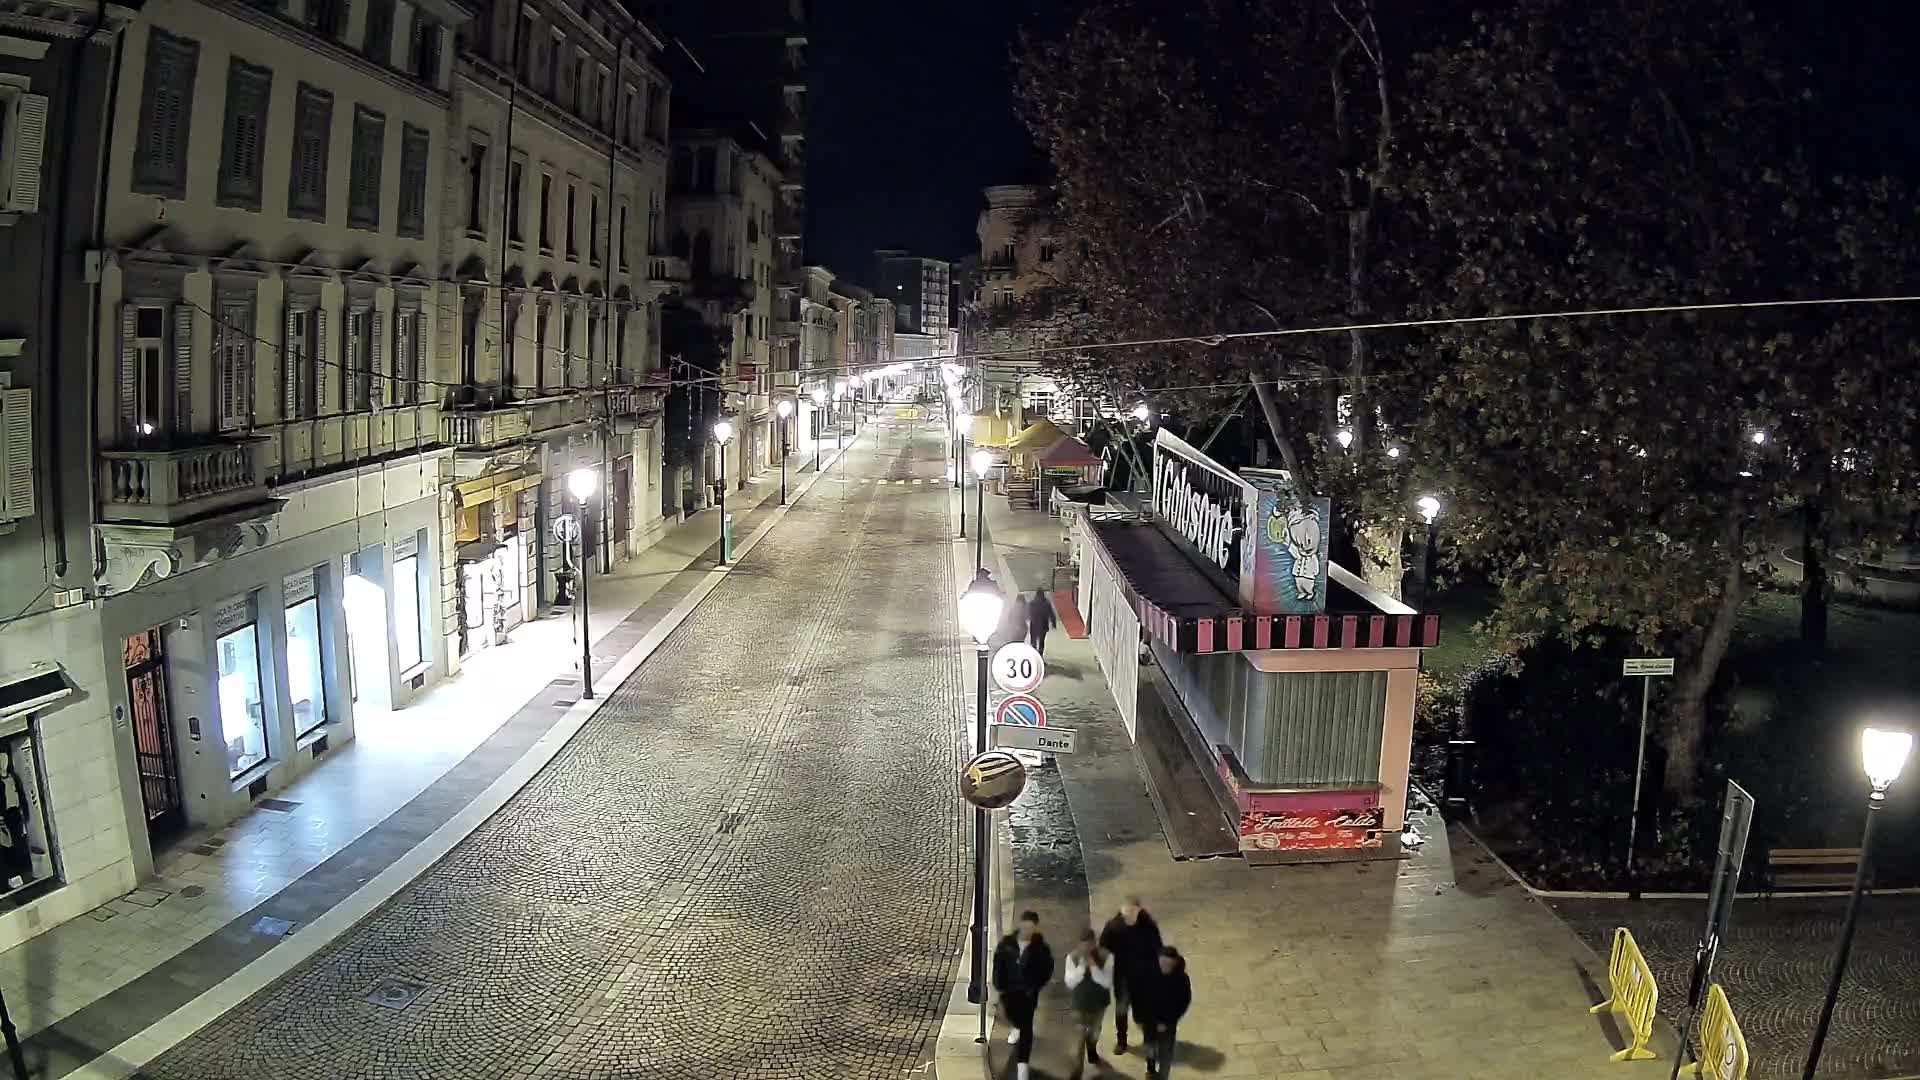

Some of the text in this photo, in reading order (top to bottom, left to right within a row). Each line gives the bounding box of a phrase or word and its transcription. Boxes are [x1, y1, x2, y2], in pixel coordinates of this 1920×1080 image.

[1163, 458, 1233, 569] Golosone
[1006, 658, 1032, 679] 30
[1038, 737, 1070, 749] Dante
